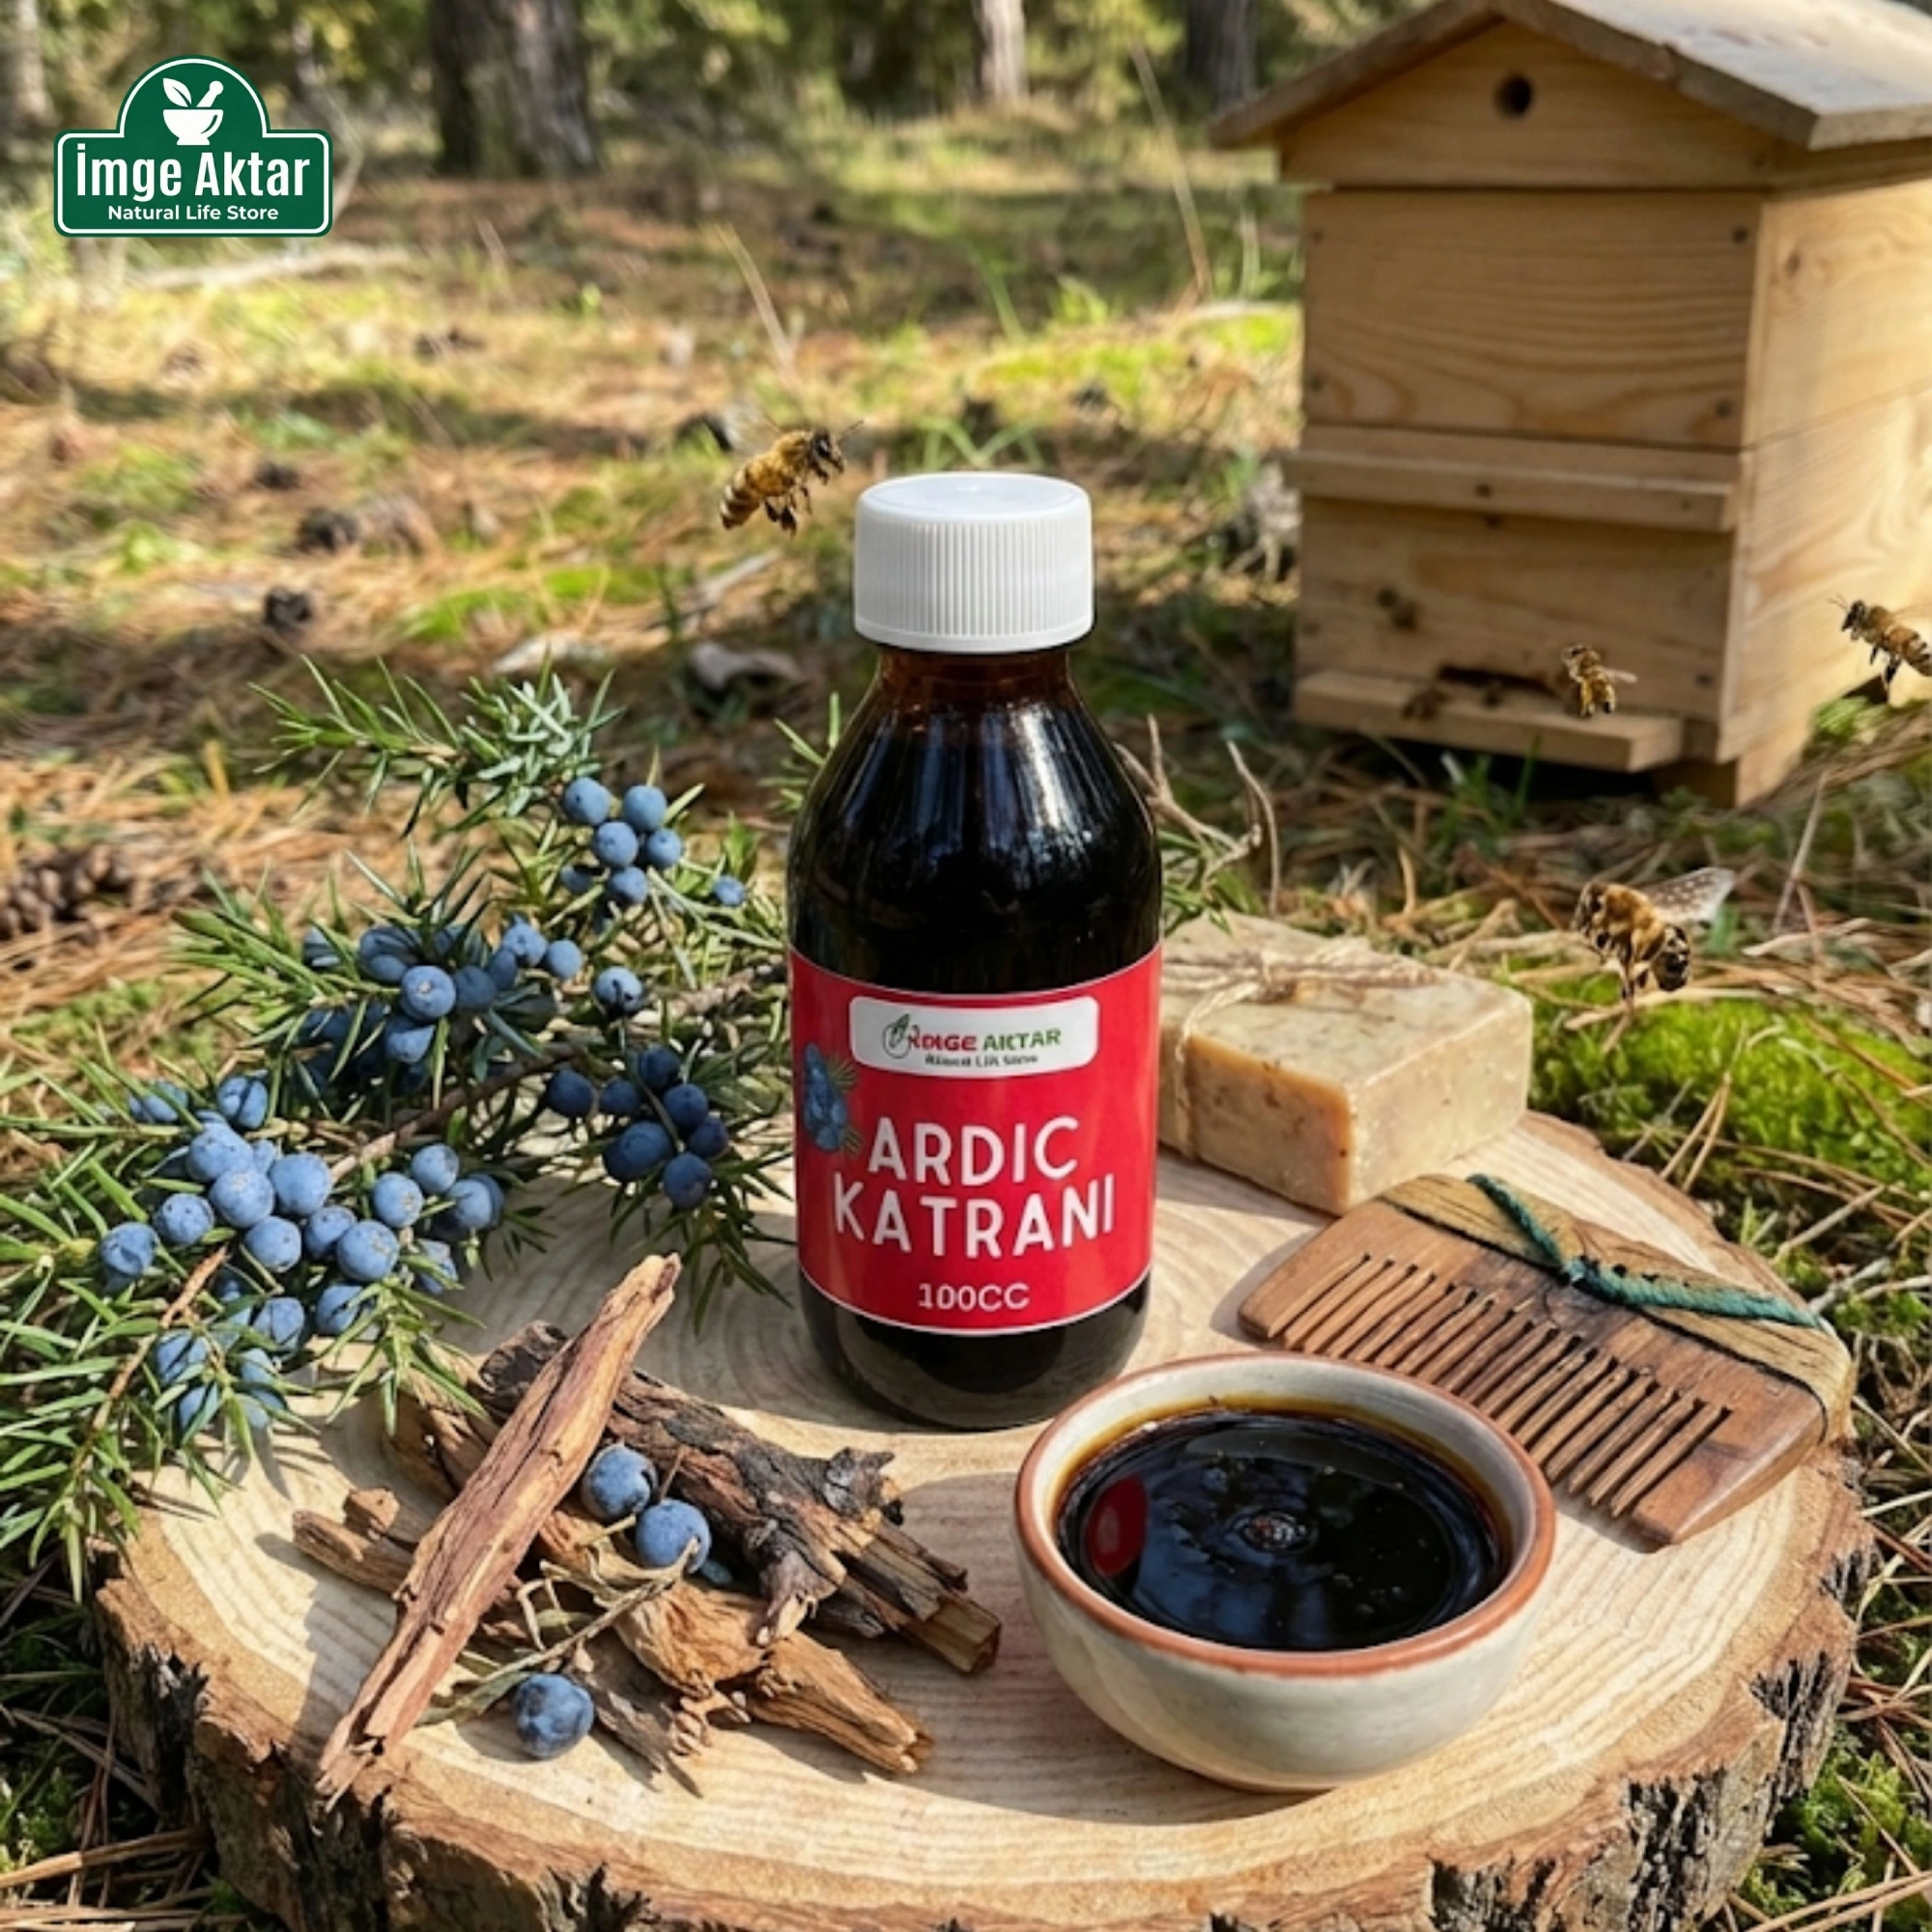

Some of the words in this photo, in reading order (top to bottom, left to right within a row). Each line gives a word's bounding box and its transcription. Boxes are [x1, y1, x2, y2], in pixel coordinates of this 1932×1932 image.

[868, 1116, 1079, 1186] ARDIC
[834, 1172, 1115, 1259] KATRANI
[919, 1283, 1030, 1311] 100CC
